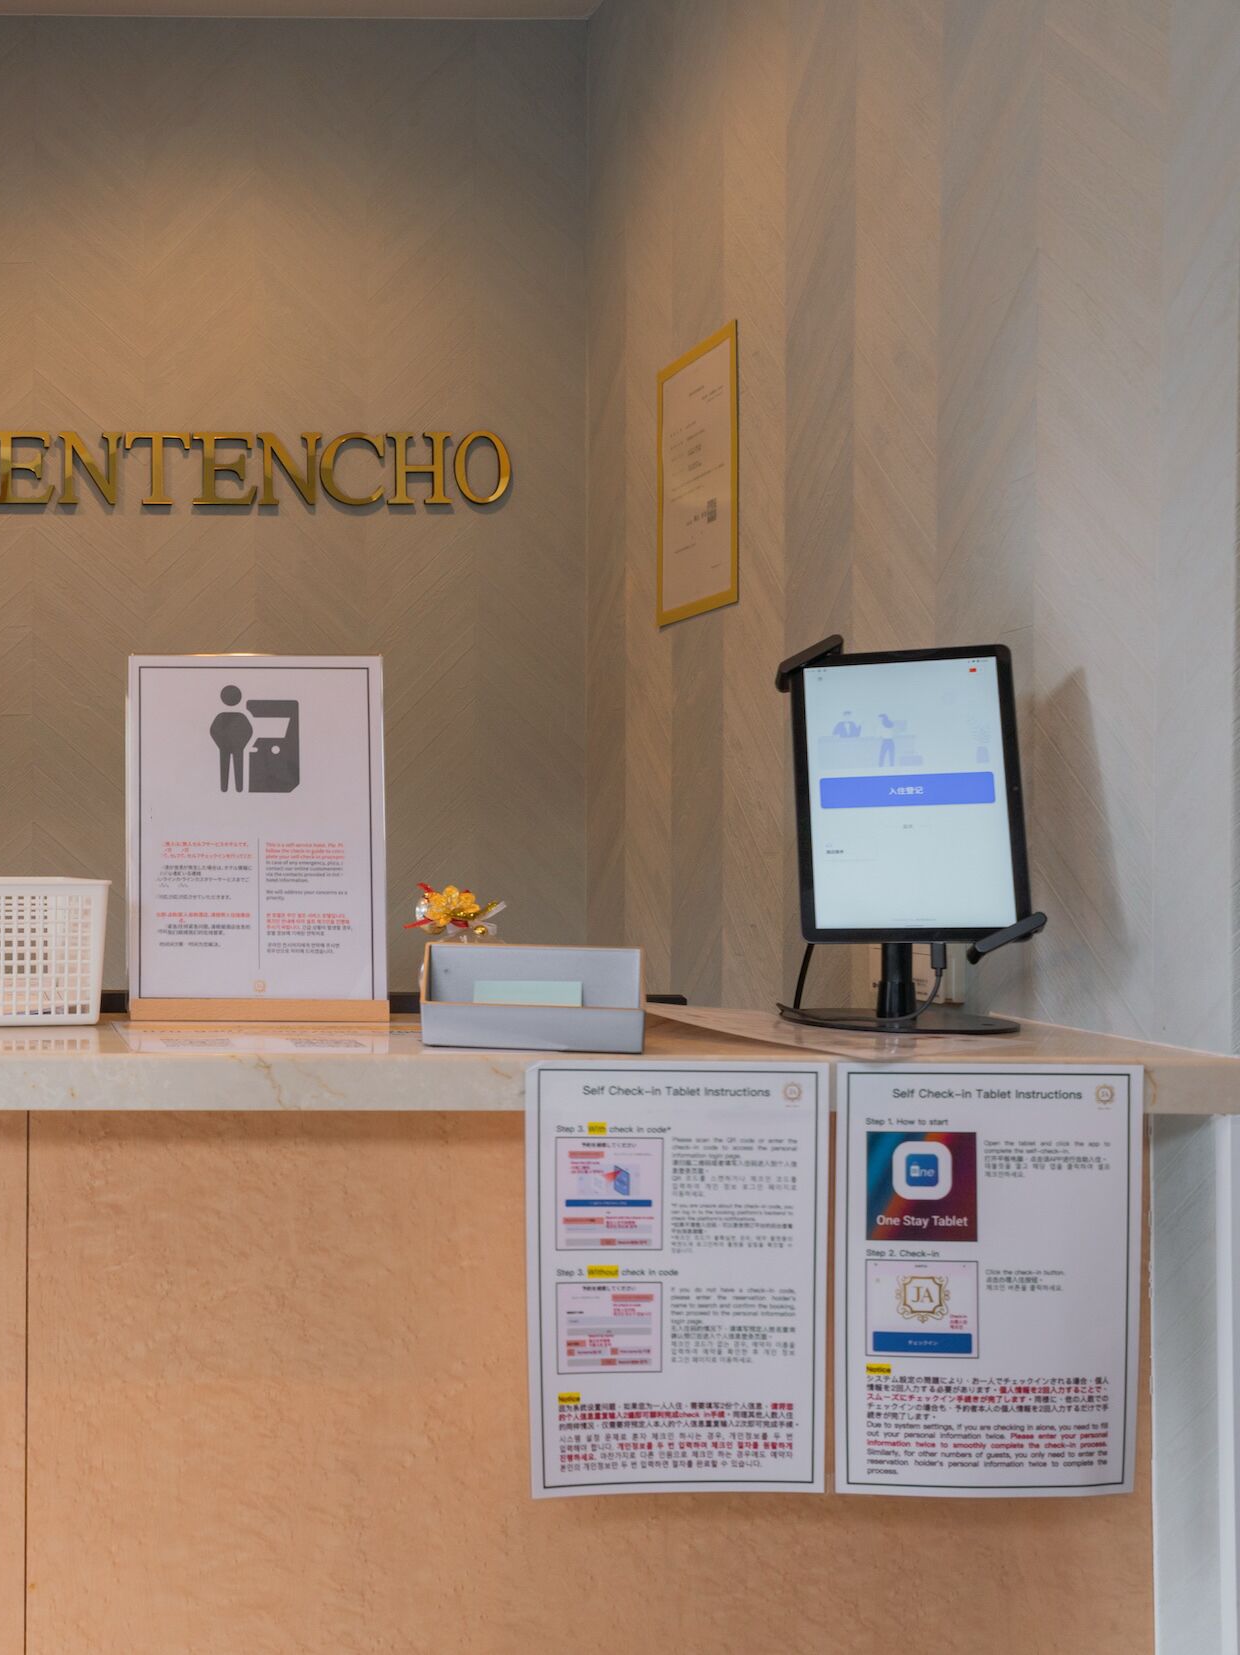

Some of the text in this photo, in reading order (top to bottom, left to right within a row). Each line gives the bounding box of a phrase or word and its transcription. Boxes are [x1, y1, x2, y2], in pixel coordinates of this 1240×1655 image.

[582, 1085, 773, 1097] Self Check-in Tablet Instructions
[891, 1088, 1082, 1099] Self Check-in Tablet Instructions
[865, 1117, 885, 1126] Step
[895, 1117, 915, 1126] How
[917, 1118, 927, 1126] to
[928, 1118, 948, 1126] start
[554, 1125, 575, 1134] Step
[876, 1214, 968, 1228] One Stay Tablet
[865, 1248, 940, 1257] Step 2. Check-in
[555, 1268, 575, 1277] Step
[588, 1268, 618, 1276] Without
[621, 1268, 646, 1276] check
[648, 1268, 656, 1276] in
[658, 1268, 679, 1276] code
[912, 1286, 934, 1303] JA
[866, 1365, 891, 1373] Notice
